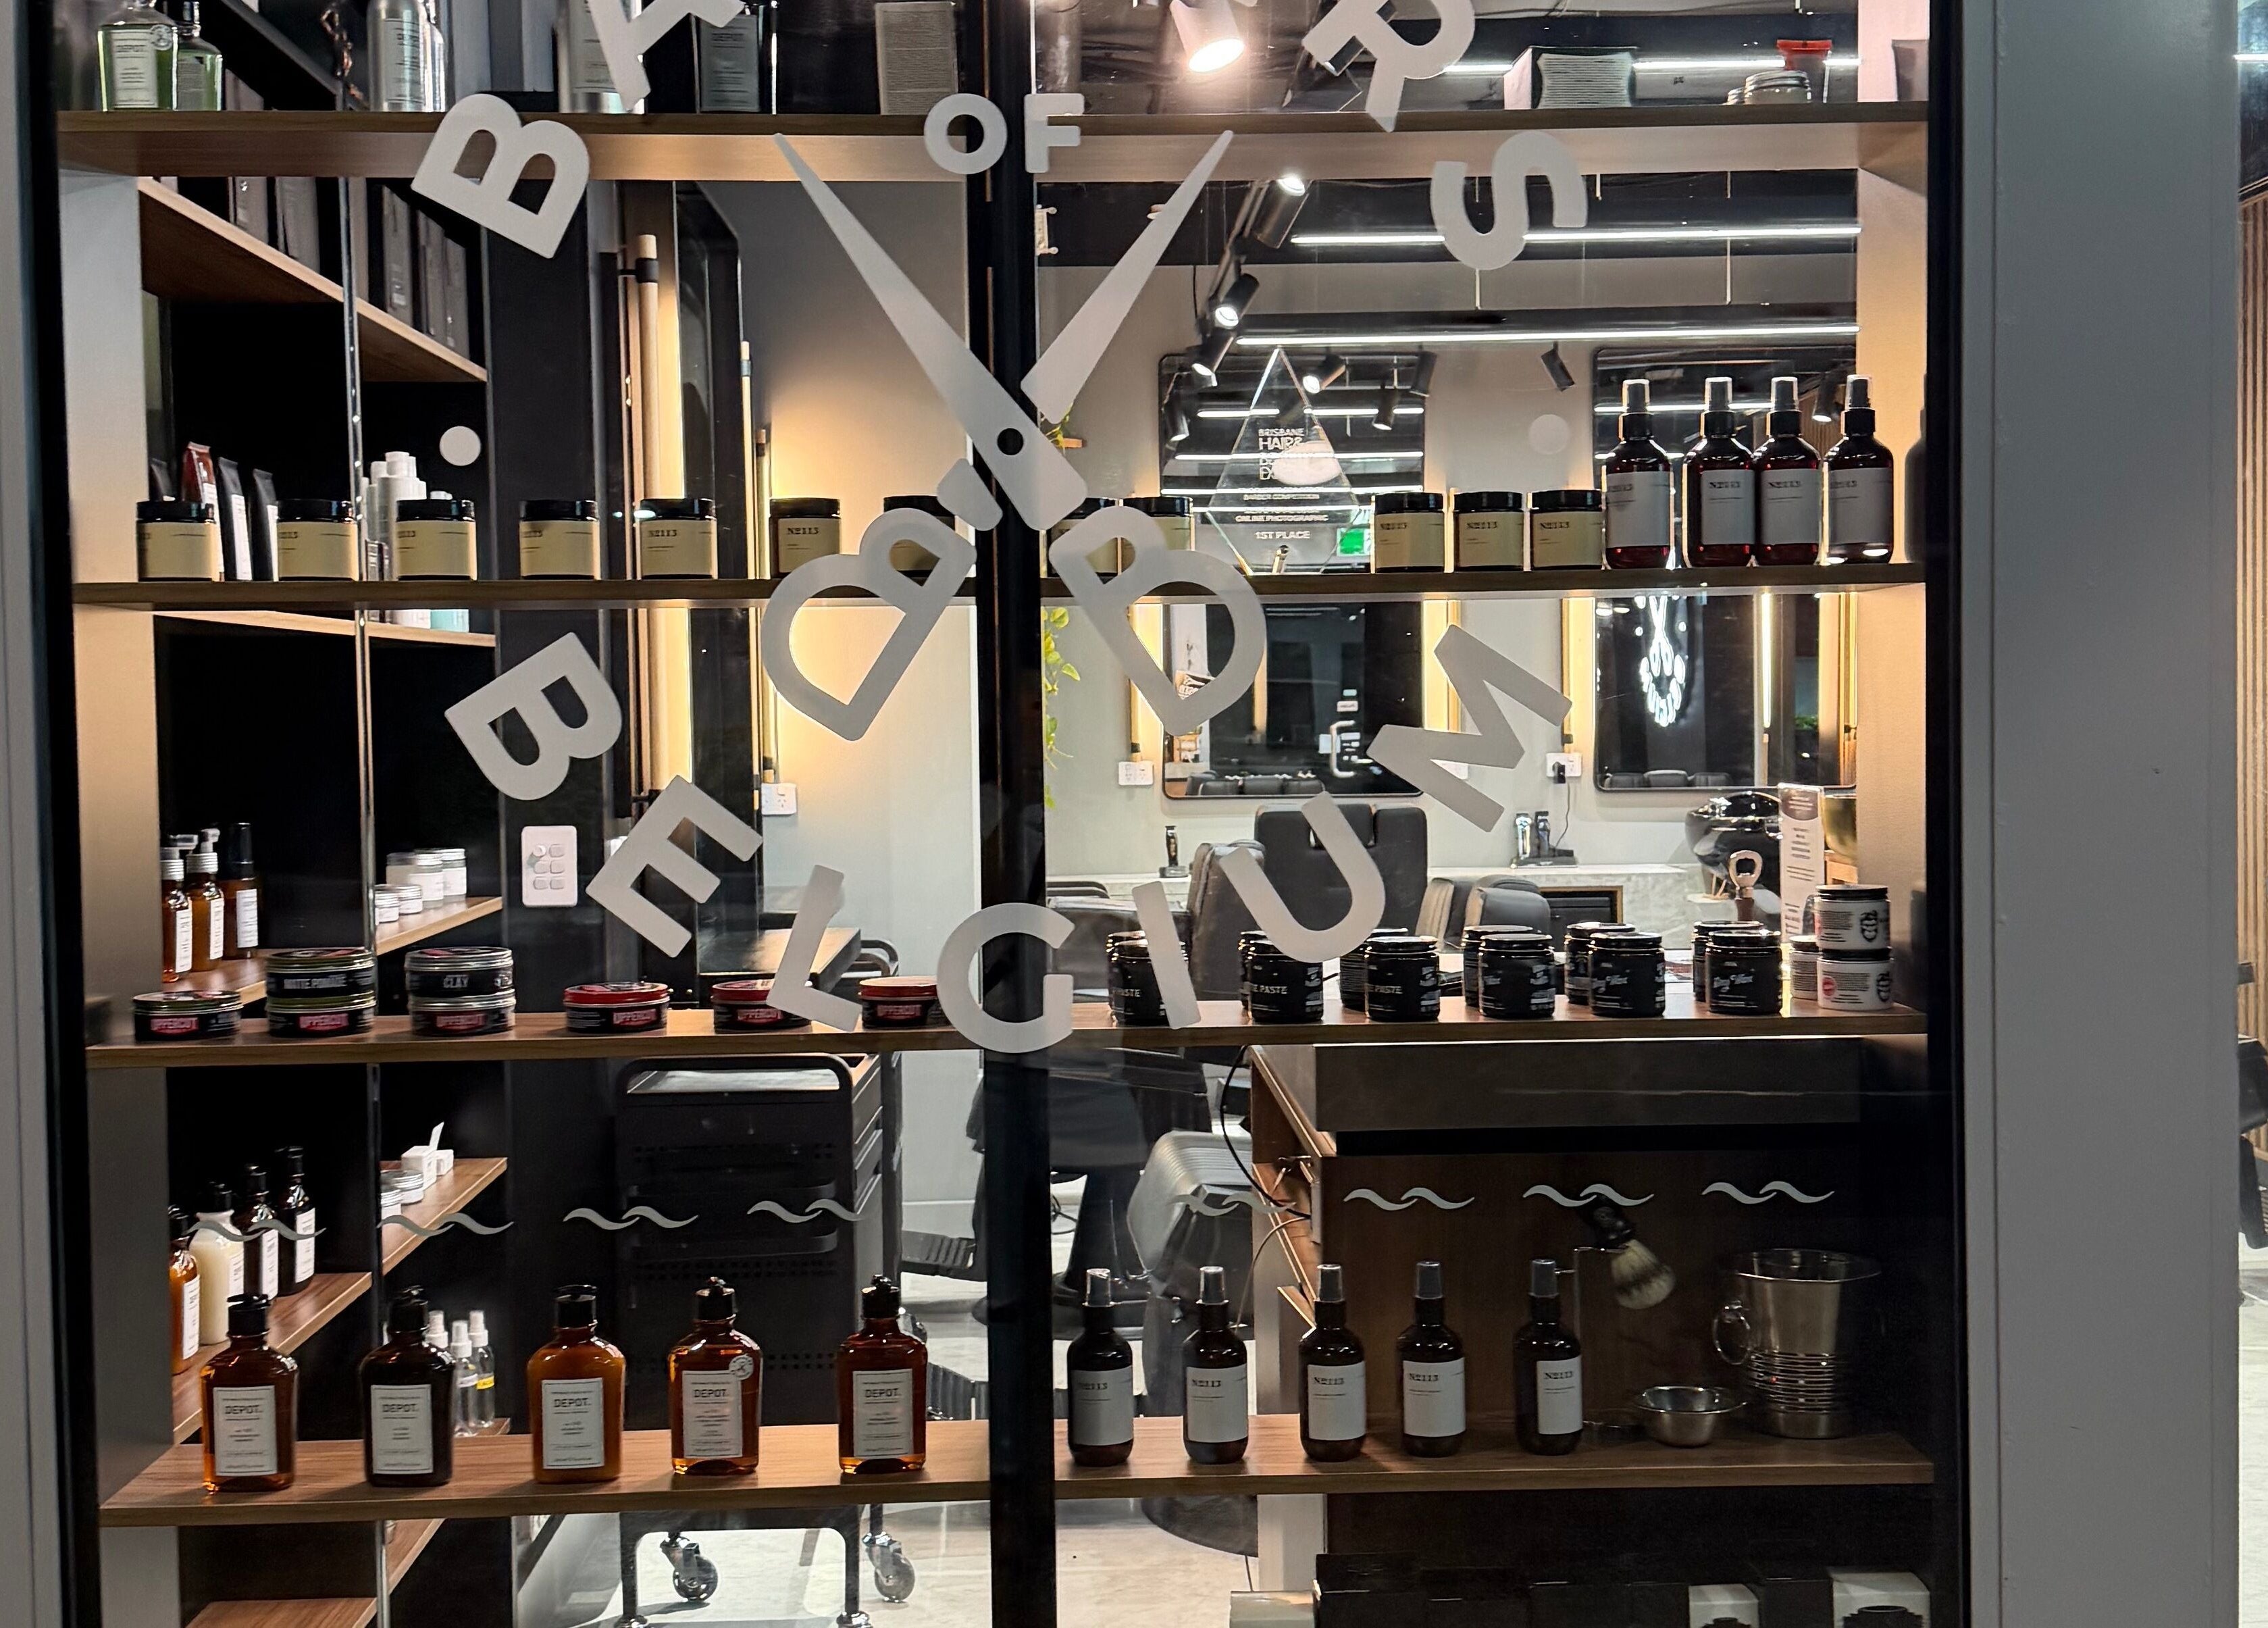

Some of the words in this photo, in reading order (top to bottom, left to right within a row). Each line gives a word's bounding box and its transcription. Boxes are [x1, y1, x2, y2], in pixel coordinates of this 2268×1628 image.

[923, 93, 1085, 174] OF
[1276, 531, 1310, 539] PLACE
[444, 624, 1572, 1052] BELGIUM
[443, 975, 469, 988] CLAY
